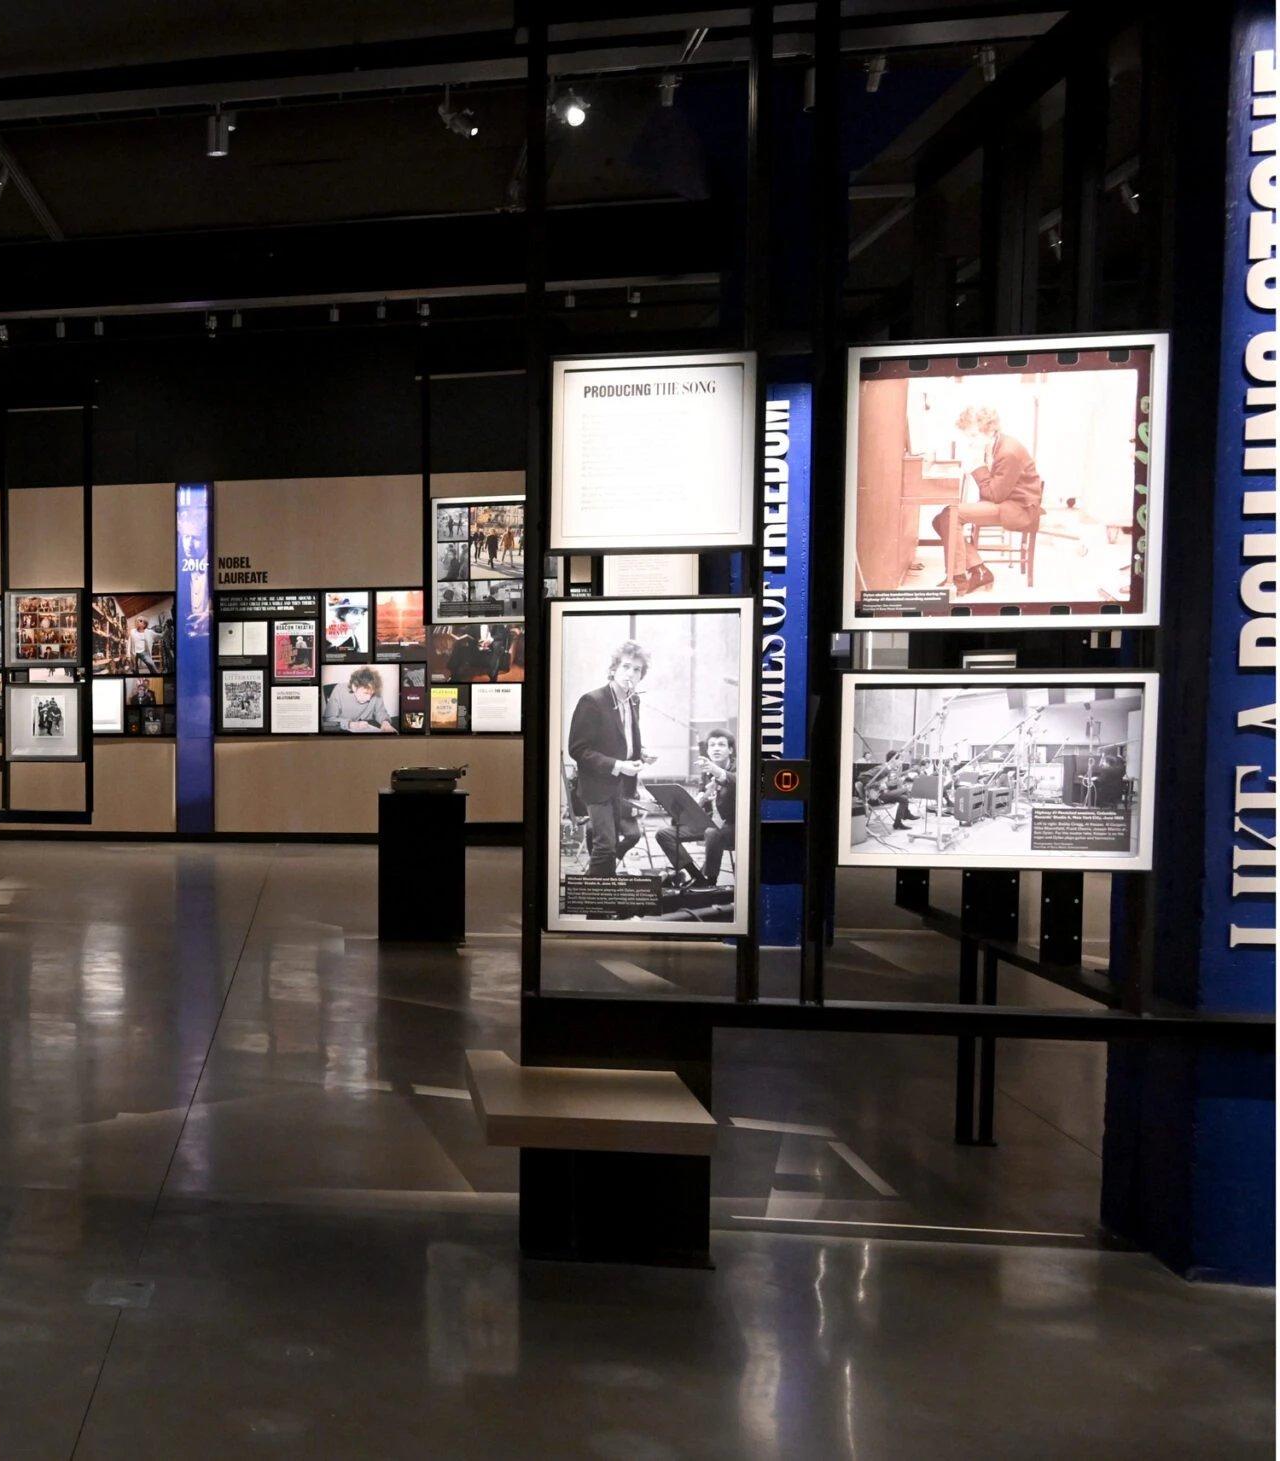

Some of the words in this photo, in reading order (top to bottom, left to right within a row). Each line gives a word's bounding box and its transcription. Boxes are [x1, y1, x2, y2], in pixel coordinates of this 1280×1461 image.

[584, 383, 651, 398] PRODUCING
[654, 382, 680, 396] THE
[682, 380, 716, 395] SONG
[763, 400, 790, 567] FREEDOM
[218, 557, 251, 569] NOBEL
[218, 571, 268, 584] LAUREATE
[761, 635, 786, 760] HIMES
